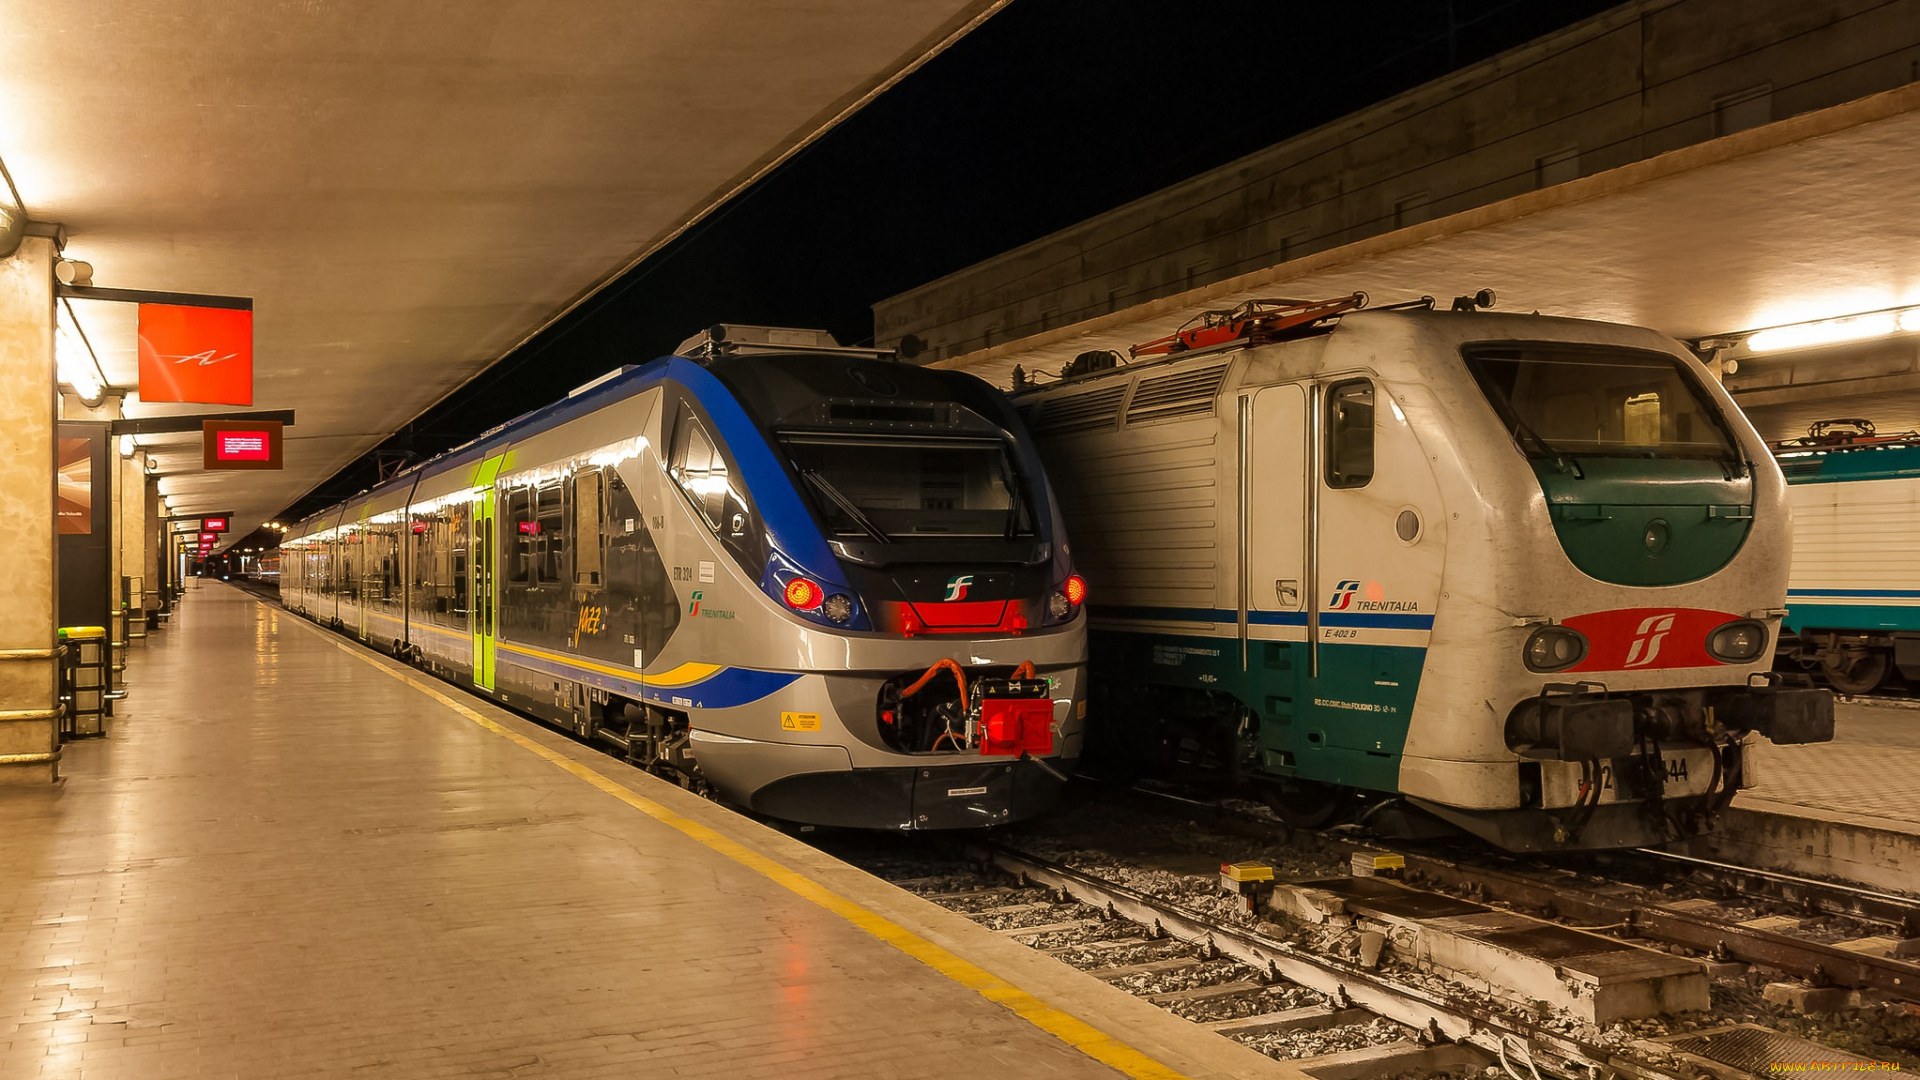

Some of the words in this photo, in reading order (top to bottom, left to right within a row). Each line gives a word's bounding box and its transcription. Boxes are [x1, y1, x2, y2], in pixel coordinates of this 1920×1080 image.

[673, 566, 682, 582] ETR
[682, 567, 693, 582] 324
[1356, 601, 1418, 612] TRENITALIA
[702, 609, 736, 620] TRENITALIA
[1324, 629, 1332, 638] E
[1333, 630, 1348, 638] 402
[1350, 630, 1357, 638] B
